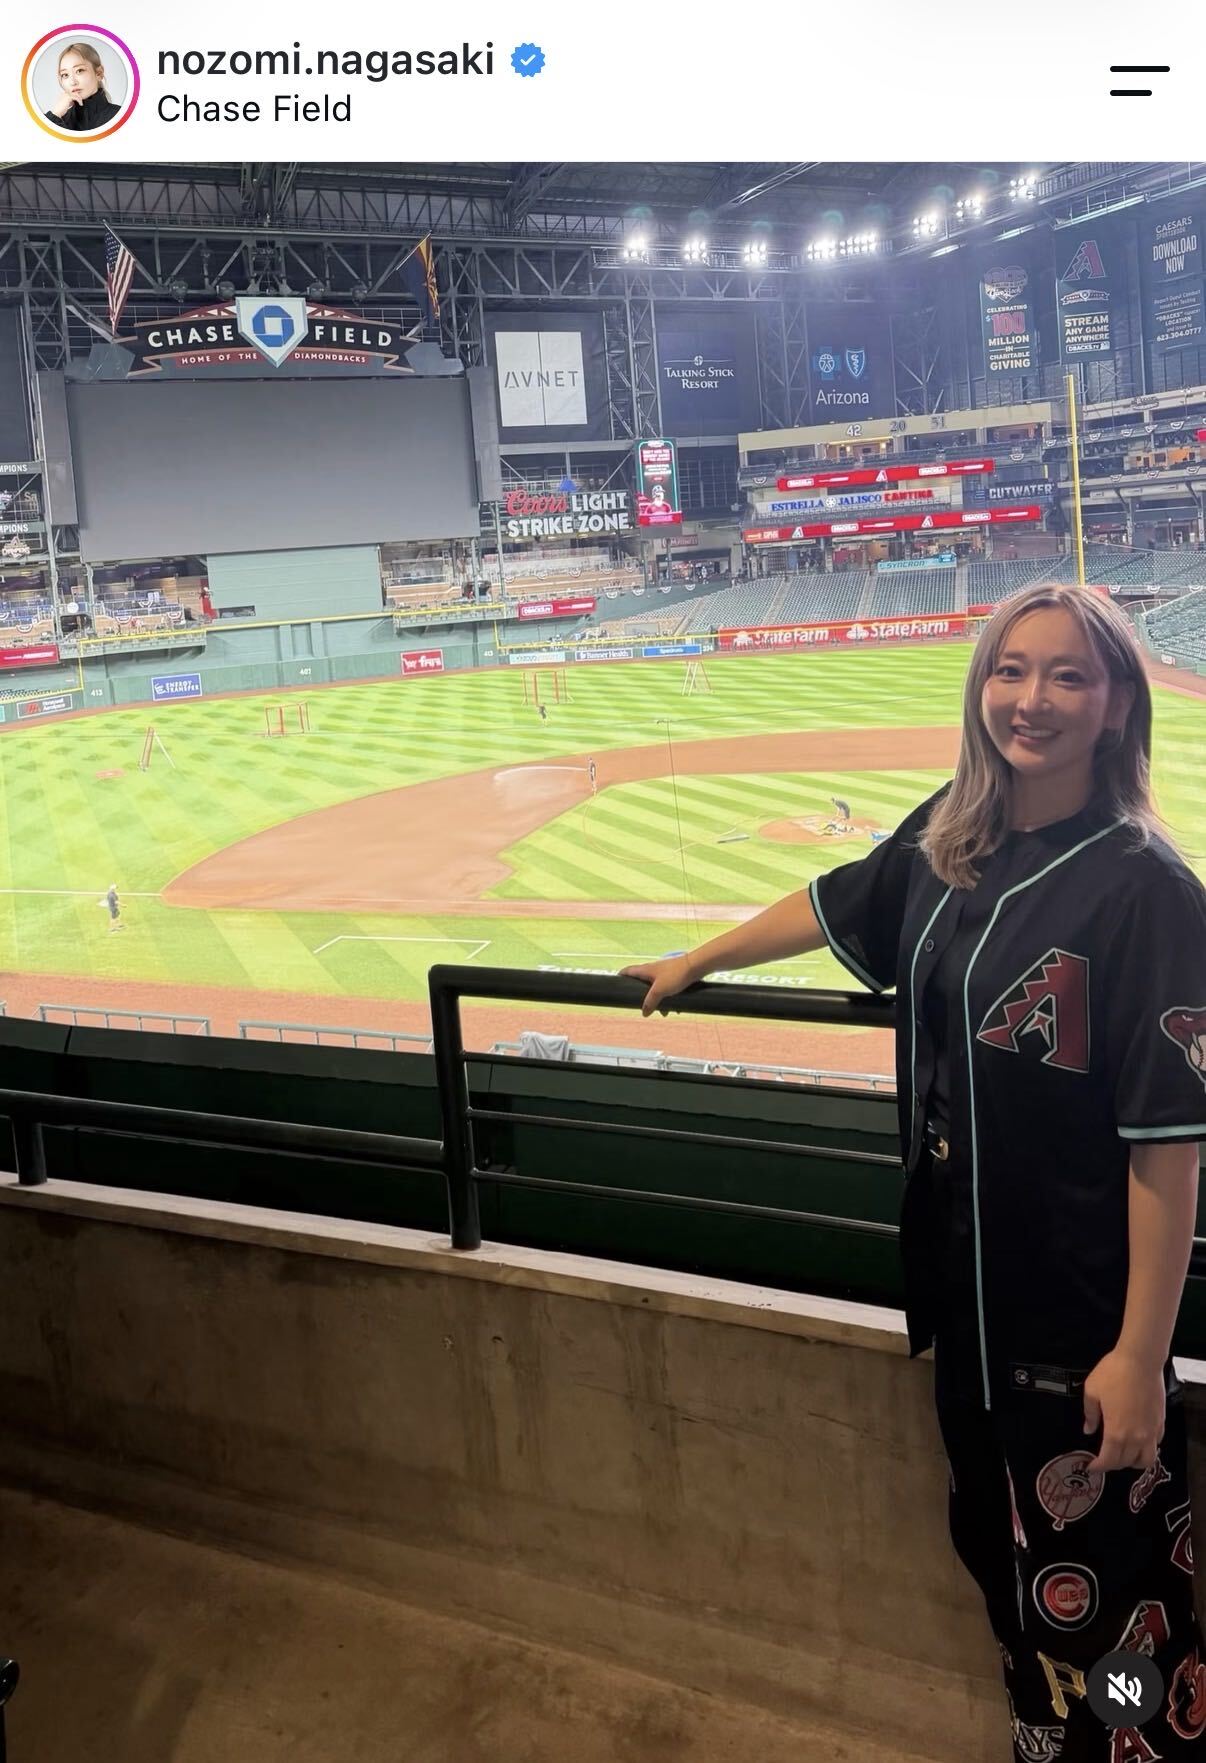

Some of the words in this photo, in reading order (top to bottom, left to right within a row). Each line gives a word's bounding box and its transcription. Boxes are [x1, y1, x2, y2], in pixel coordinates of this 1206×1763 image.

[1155, 215, 1192, 234] CAESARS
[1153, 235, 1197, 261] DOWNLOAD
[1166, 254, 1185, 275] NOW
[986, 303, 1028, 314] CELEBRATING
[1064, 315, 1109, 328] STREAM
[148, 325, 234, 349] CHASE
[314, 325, 393, 348] FIELD
[1065, 327, 1083, 336] ANY
[1086, 324, 1109, 334] GAME
[988, 335, 1030, 347] MILLION
[1066, 333, 1110, 344] ANYWHERE
[181, 355, 211, 365] HOME
[218, 354, 232, 362] OF
[239, 353, 258, 361] THE
[294, 353, 367, 364] DIAMONDBACKS
[989, 351, 1031, 361] CHARITABLE
[664, 366, 708, 379] TALKING
[710, 366, 735, 378] STICK
[990, 359, 1031, 371] GIVING
[504, 370, 580, 389] AVNET
[681, 378, 719, 390] RESORT
[816, 388, 870, 405] Arizona
[845, 424, 862, 437] 42
[890, 420, 906, 433] 20
[931, 415, 946, 428] 51
[989, 483, 1053, 499] CUTWATER
[506, 489, 569, 516] Coors
[571, 492, 628, 512] LIGHT
[771, 499, 825, 513] ESTRELLA
[837, 493, 882, 507] JALISCO
[884, 489, 934, 503] CANTINA
[507, 516, 574, 538] STRIKE
[90, 689, 103, 697] 413
[714, 970, 817, 986] RESORT
